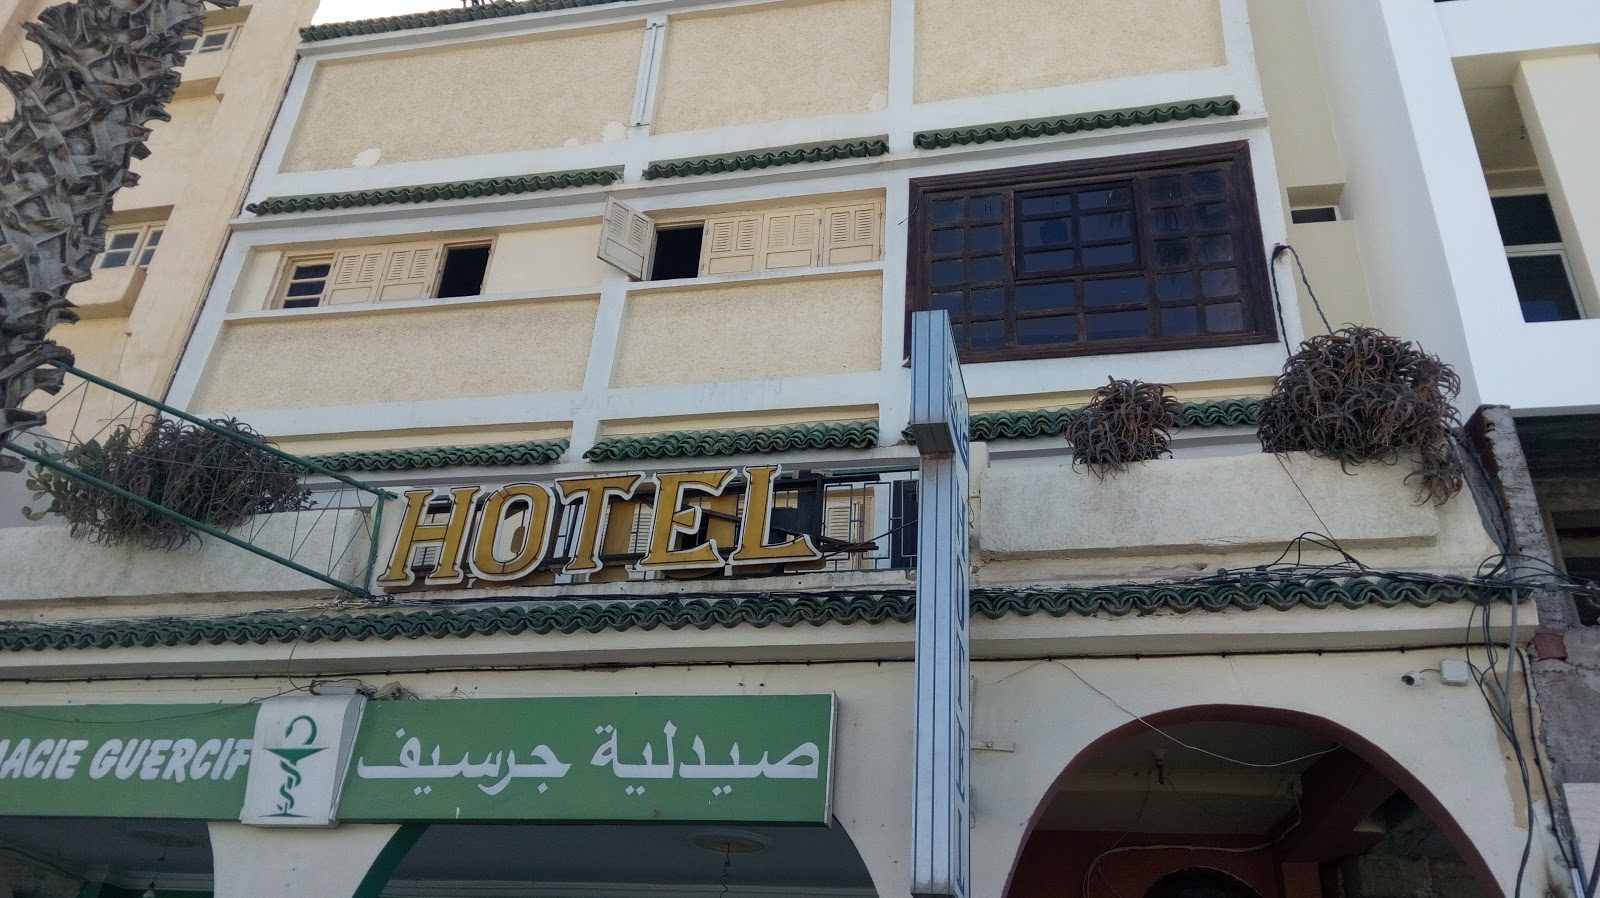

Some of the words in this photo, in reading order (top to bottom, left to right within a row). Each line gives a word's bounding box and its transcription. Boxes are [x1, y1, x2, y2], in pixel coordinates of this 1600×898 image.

[377, 464, 822, 587] HOTEL
[89, 738, 254, 782] GUERCIF
[357, 727, 572, 796] جرسيف
[590, 719, 820, 797] صيدلية
